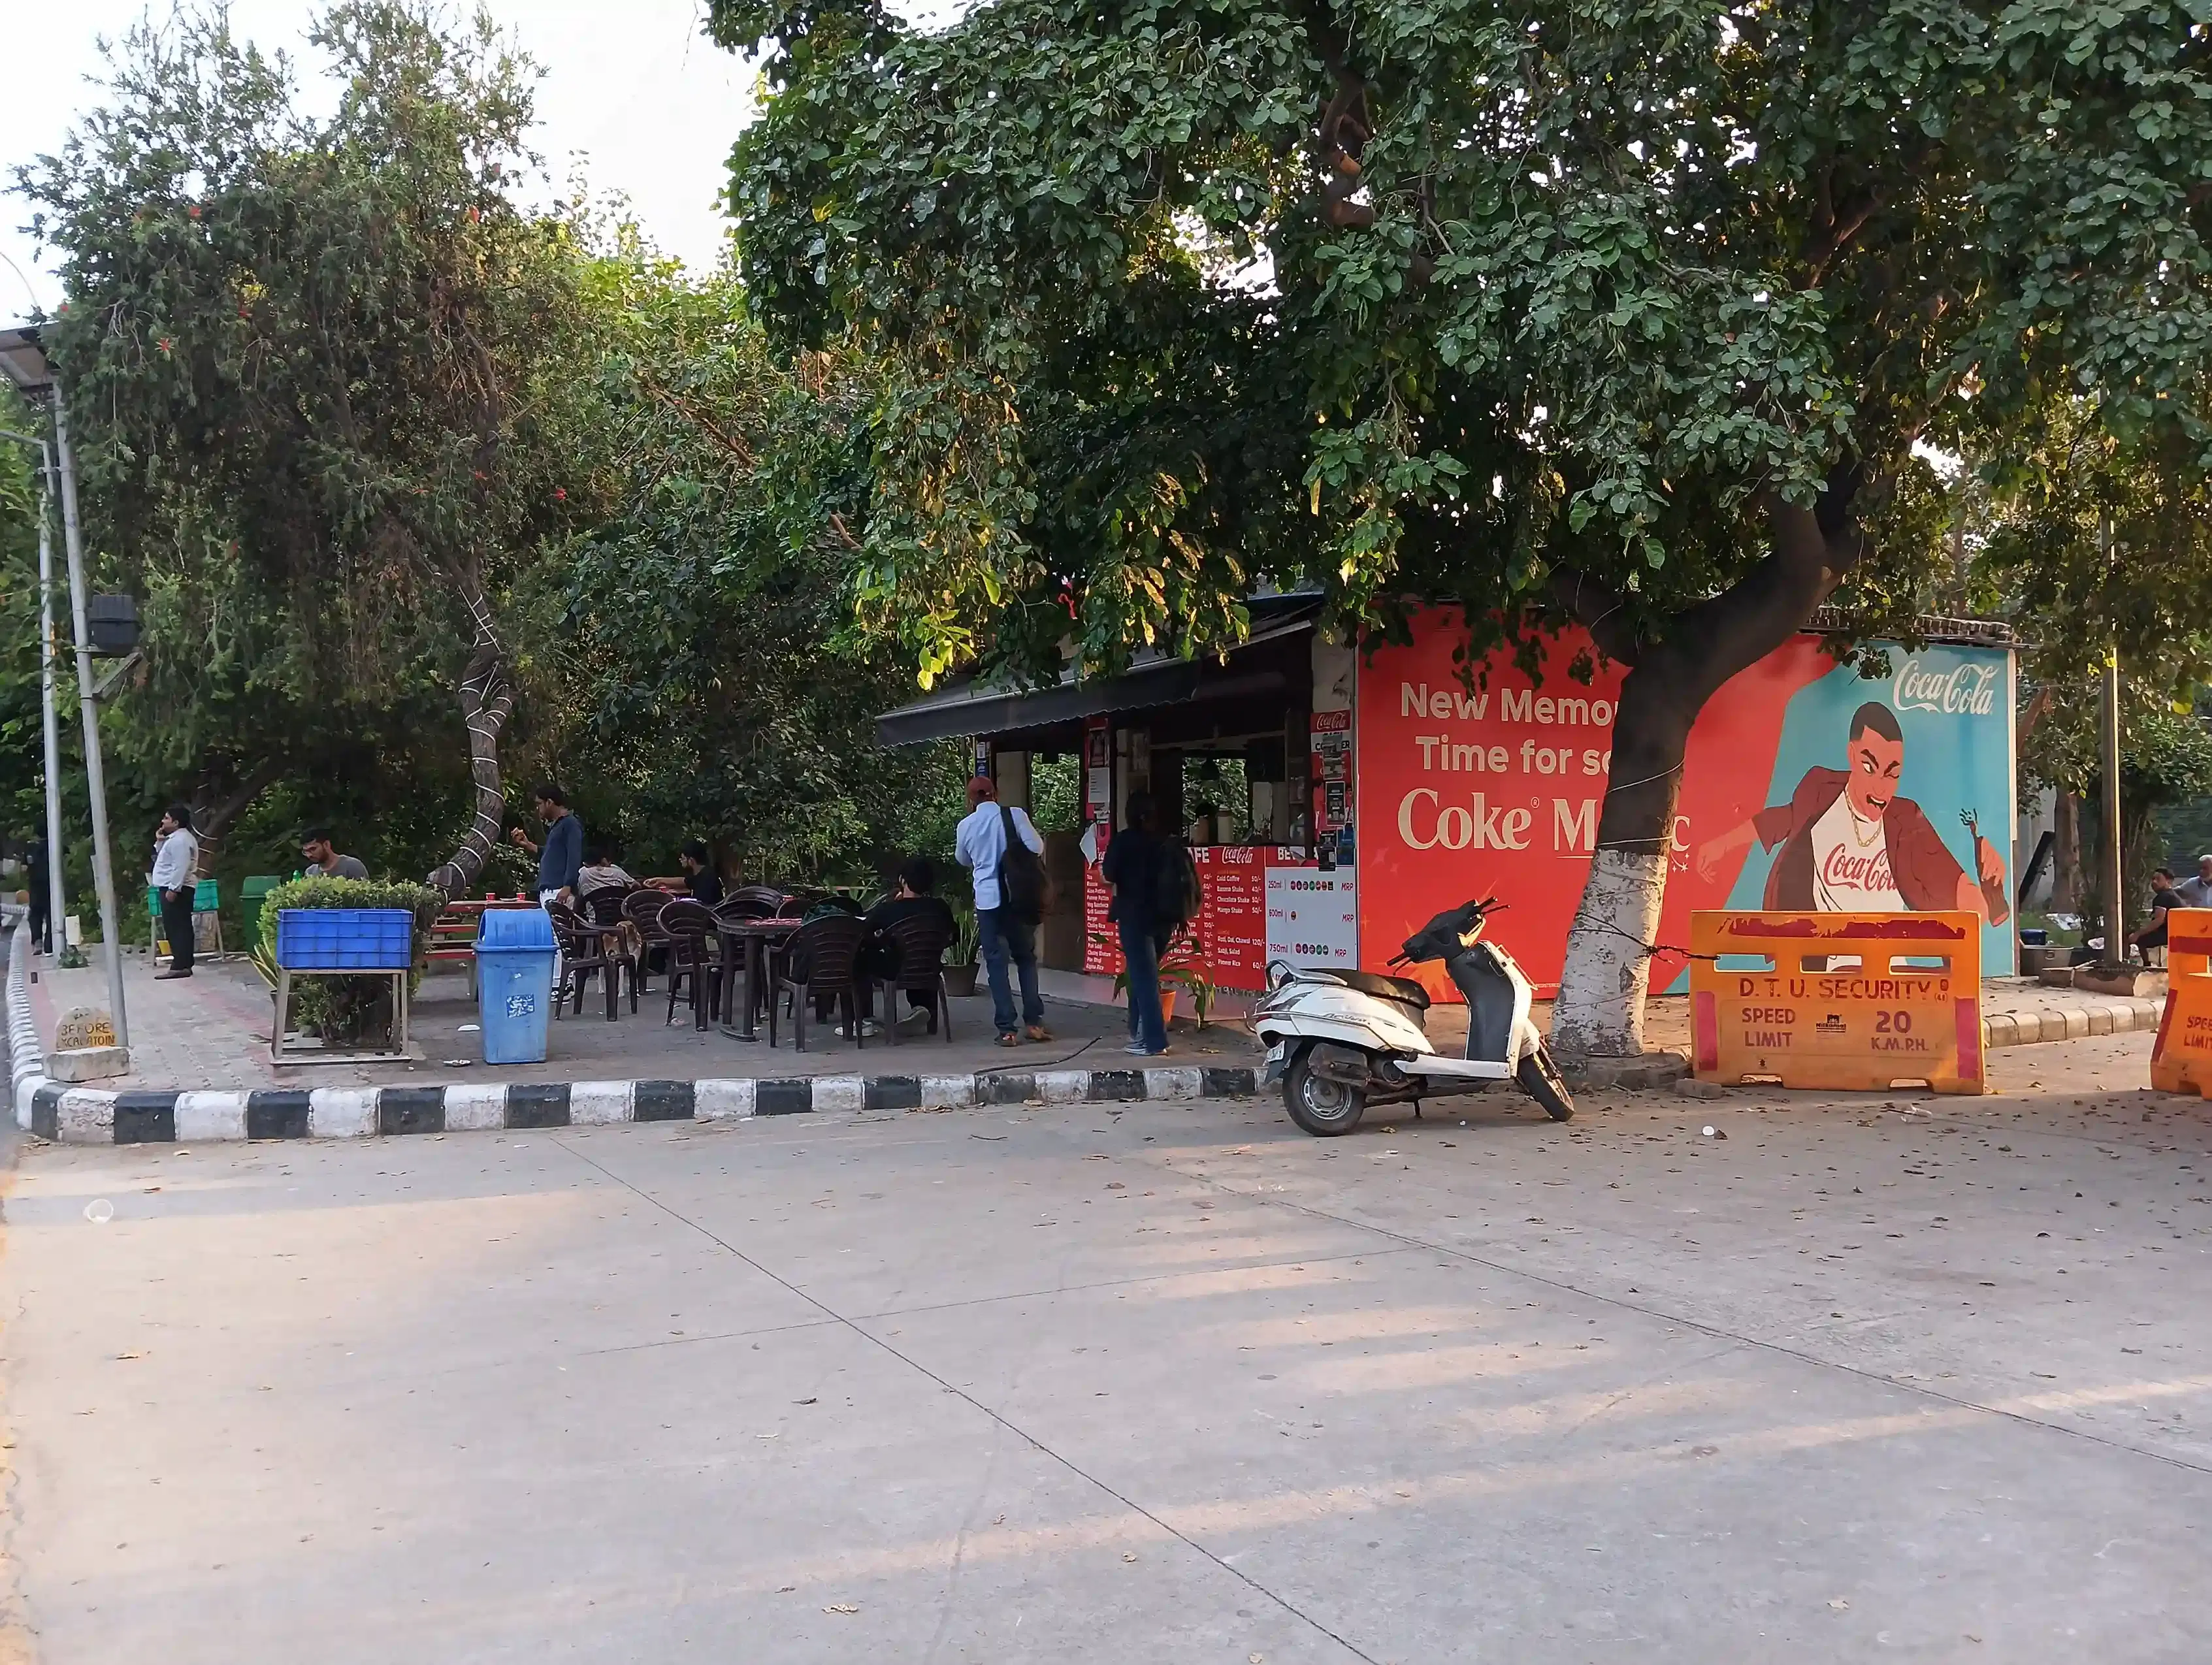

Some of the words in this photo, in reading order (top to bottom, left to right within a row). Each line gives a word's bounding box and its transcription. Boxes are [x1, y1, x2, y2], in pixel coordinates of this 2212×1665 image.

[1893, 660, 1999, 715] Coca-Cola
[1401, 682, 1489, 720] New
[1415, 734, 1509, 772] Time
[1520, 739, 1572, 774] for
[1341, 882, 1354, 891] MRP
[1341, 913, 1354, 922] MRP
[1269, 943, 1288, 953] 750ml
[1335, 948, 1347, 957] MRP
[1819, 978, 1931, 1000] SECURITY
[1742, 1007, 1796, 1024] SPEED
[1876, 1010, 1911, 1033] 20
[1745, 1031, 1793, 1048] LIMIT
